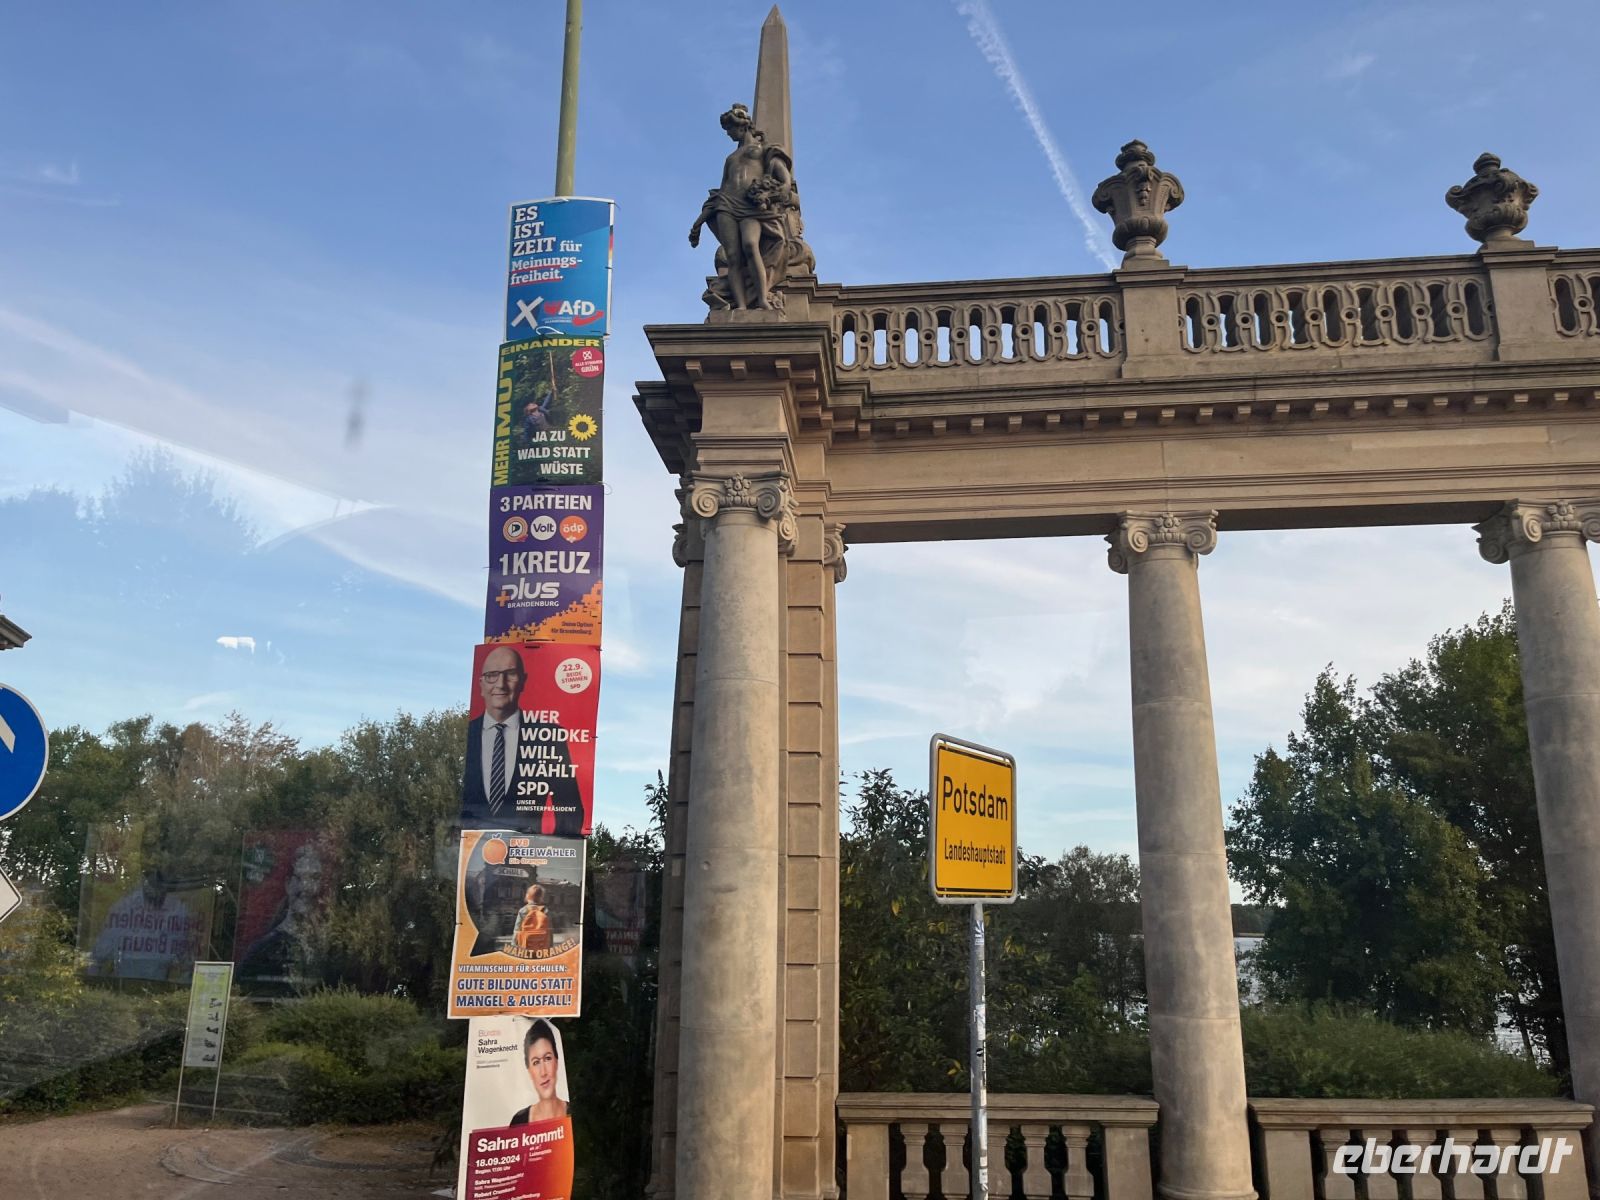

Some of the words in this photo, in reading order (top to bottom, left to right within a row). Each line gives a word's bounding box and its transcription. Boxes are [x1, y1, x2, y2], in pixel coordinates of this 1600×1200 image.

[515, 206, 538, 223] ES
[513, 221, 544, 239] IST
[512, 237, 556, 257] ZEIT
[559, 240, 582, 252] für
[511, 256, 583, 272] Meinungs-
[510, 268, 564, 286] freiheit.
[558, 300, 595, 316] AfD
[501, 338, 600, 356] EINANDER
[497, 357, 513, 437] MUT
[532, 431, 548, 443] JA
[549, 430, 566, 442] ZU
[517, 448, 551, 461] WALD
[552, 446, 591, 459] STATT
[494, 439, 509, 486] MEHR
[540, 460, 584, 475] WÜSTE
[500, 496, 511, 512] 3
[513, 493, 592, 511] PARTEIEN
[533, 523, 555, 533] Volt
[563, 522, 585, 534] ödp
[499, 553, 509, 576] 1
[512, 550, 590, 575] KREUZ
[501, 577, 560, 601] plus
[507, 600, 560, 609] BRANDENBURG
[562, 663, 584, 672] 22.9.
[561, 675, 589, 684] STIMMEN
[522, 710, 560, 724] WER
[521, 727, 590, 743] WOIDKE
[519, 745, 563, 762] WILL,
[518, 761, 579, 778] WÄHLT
[516, 781, 554, 796] SPD.
[942, 775, 1008, 821] Potsdam
[515, 805, 577, 813] MINISTERPRÄSIDENT
[509, 848, 535, 857] FREIE
[536, 845, 577, 857] WÄHLER
[510, 838, 530, 848] BVB
[944, 837, 1007, 869] Landeshauptstadt
[535, 937, 577, 959] ORANGE!
[458, 964, 514, 973] VITAMINSCHUB
[514, 963, 530, 973] FÜR
[531, 964, 568, 973] SCHULEN:
[457, 978, 485, 990] GUTE
[487, 978, 538, 990] BILDUNG
[540, 978, 573, 990] STATT
[456, 994, 503, 1007] MANGEL
[506, 995, 517, 1006] &
[519, 994, 572, 1006] AUSFALL!
[478, 1044, 518, 1054] Wagenknecht
[477, 1137, 519, 1153] Sahra
[521, 1126, 565, 1147] kommt!
[475, 1154, 520, 1168] 18.09.2024
